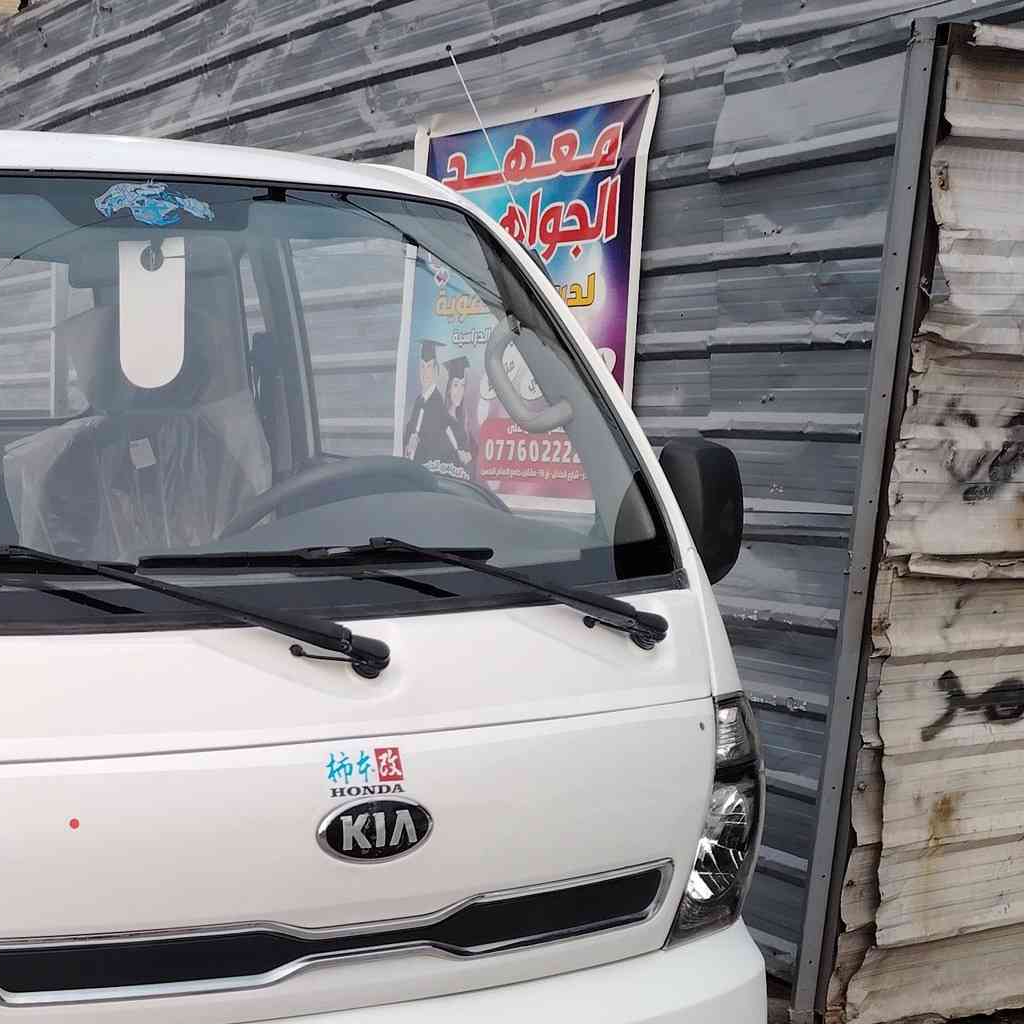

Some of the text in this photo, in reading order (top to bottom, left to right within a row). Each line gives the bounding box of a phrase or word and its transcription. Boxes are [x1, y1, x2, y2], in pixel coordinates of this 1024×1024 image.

[442, 122, 624, 191] معهد
[330, 784, 405, 798] HONDA
[340, 809, 418, 851] KIA
